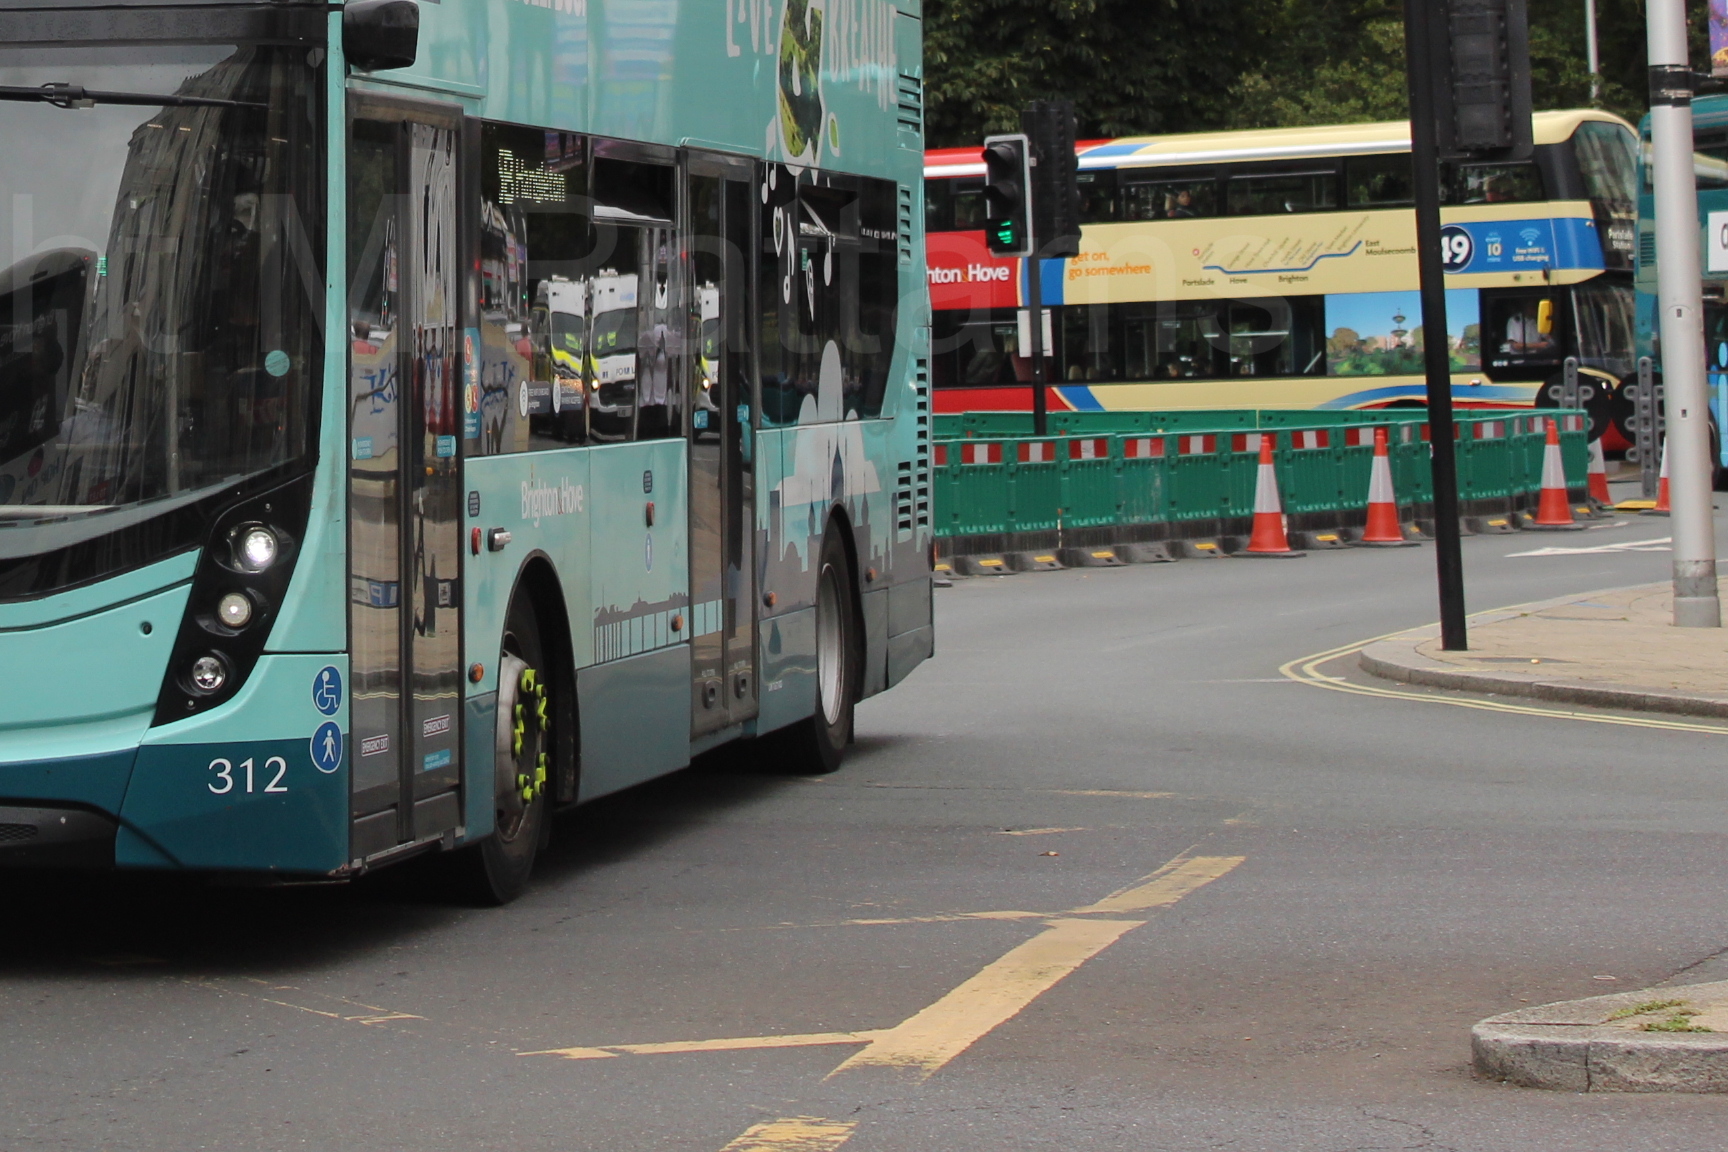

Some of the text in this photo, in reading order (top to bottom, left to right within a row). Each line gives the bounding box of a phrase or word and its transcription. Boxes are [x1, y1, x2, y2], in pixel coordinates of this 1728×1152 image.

[1441, 234, 1470, 264] 49
[1487, 243, 1502, 256] 10
[1068, 261, 1152, 281] go somewhere
[1182, 278, 1215, 286] Portslade
[1278, 275, 1309, 284] Brighton
[207, 755, 289, 795] 312
